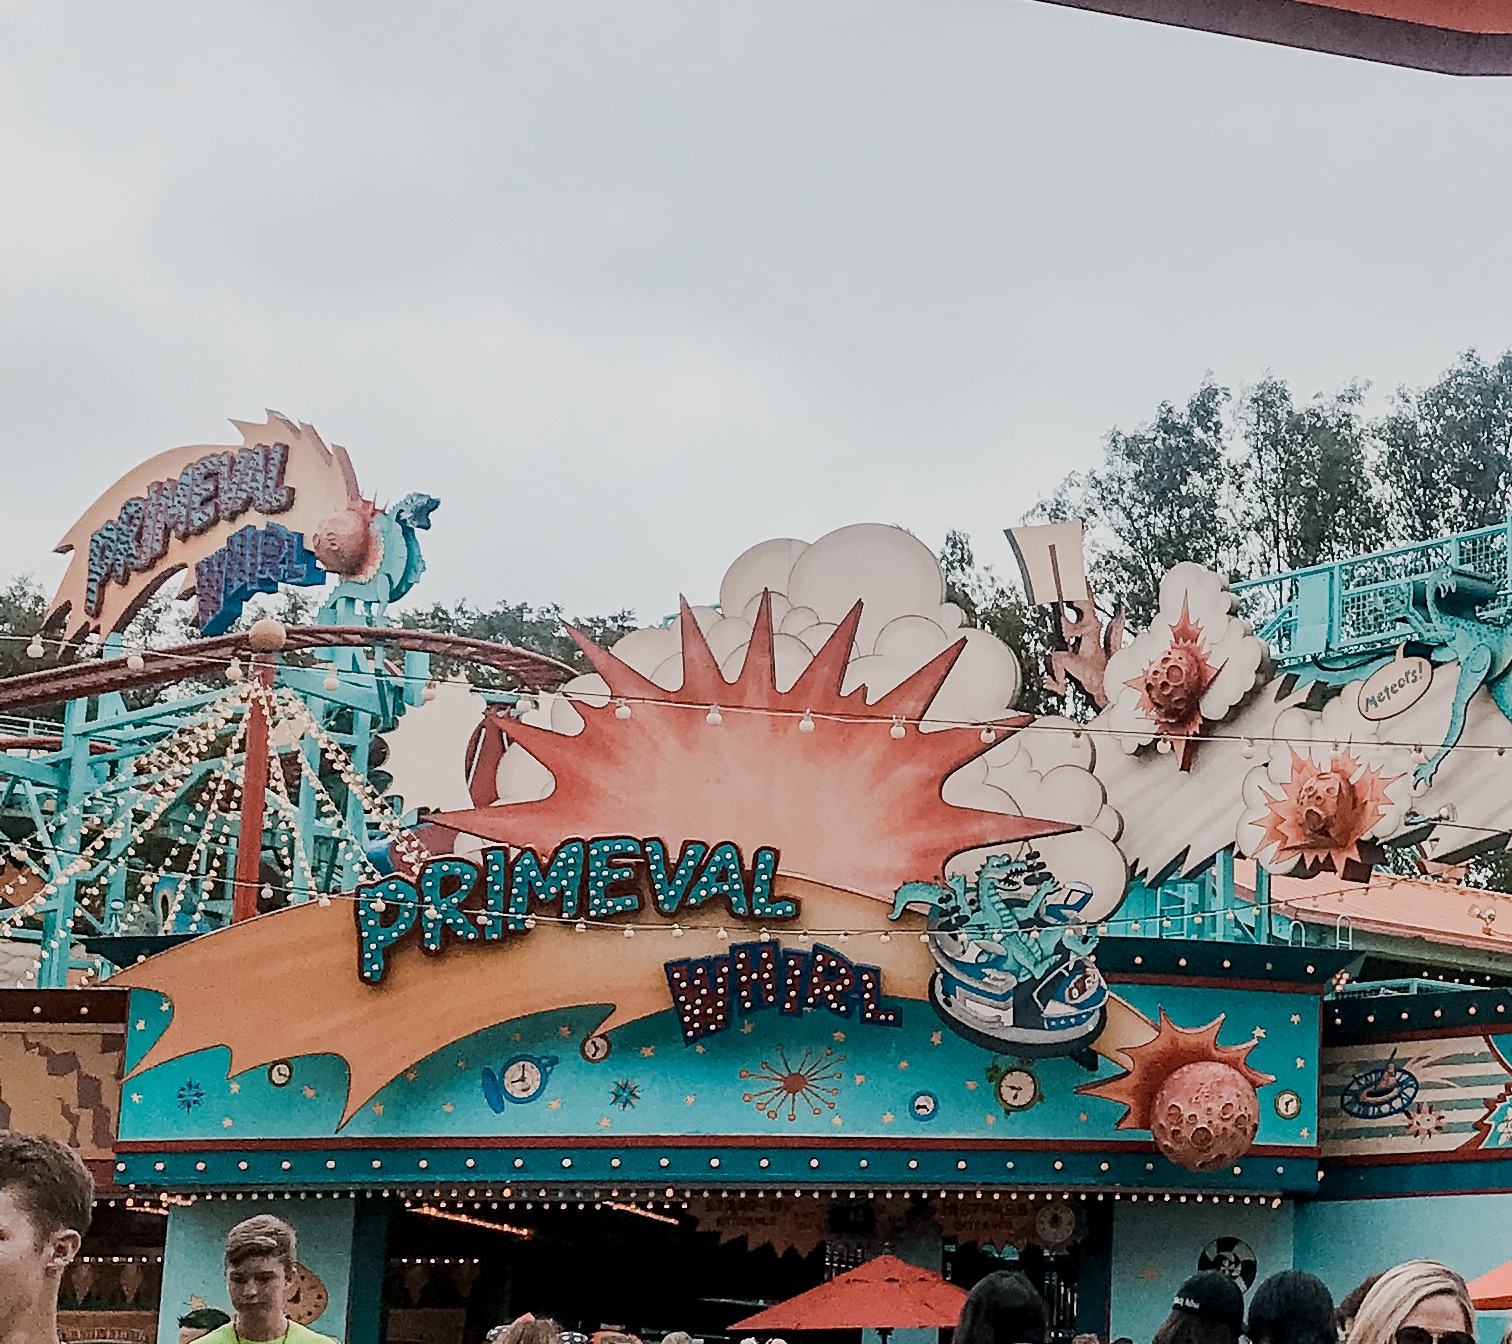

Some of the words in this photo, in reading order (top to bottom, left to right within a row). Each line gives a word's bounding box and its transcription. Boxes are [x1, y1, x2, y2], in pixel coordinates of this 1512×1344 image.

[84, 441, 296, 619] PRIMEVAL
[194, 521, 310, 637] WHIRL
[1365, 661, 1423, 712] Meteors!
[356, 836, 801, 985] PRIMEVAL
[663, 939, 903, 1046] WHIRL
